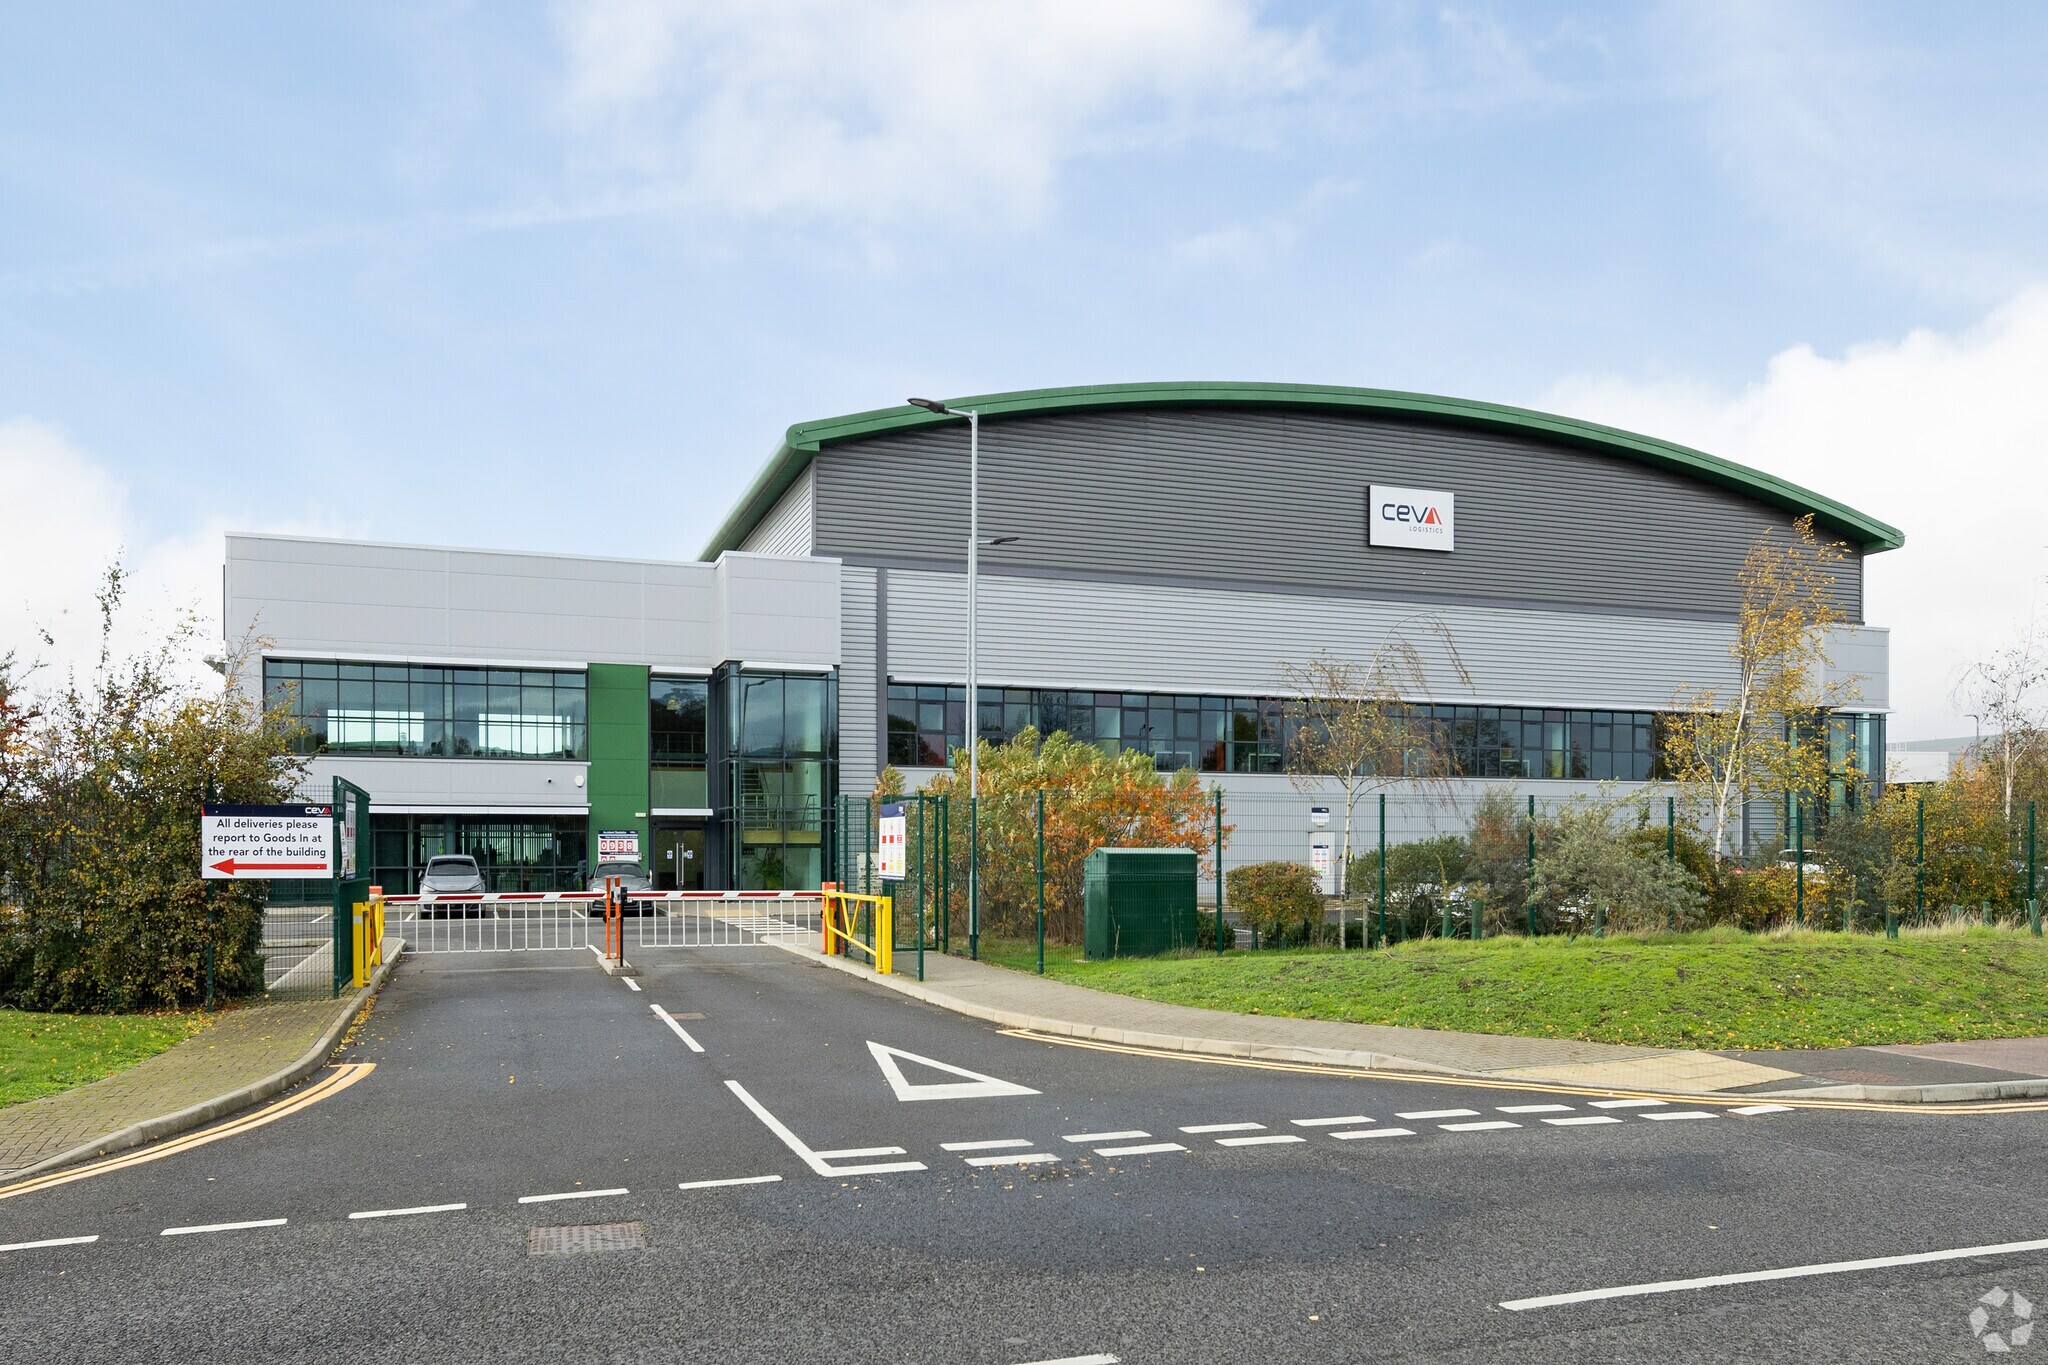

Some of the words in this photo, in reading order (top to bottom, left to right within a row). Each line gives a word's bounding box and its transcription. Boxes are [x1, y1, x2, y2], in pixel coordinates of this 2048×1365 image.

[217, 819, 230, 828] All
[234, 819, 283, 828] deliveries
[287, 820, 318, 830] please
[213, 834, 246, 844] report
[264, 833, 296, 842] Goods
[300, 834, 308, 842] In
[208, 847, 225, 856] the
[252, 847, 263, 856] of
[266, 847, 282, 856] the
[286, 847, 326, 858] building
